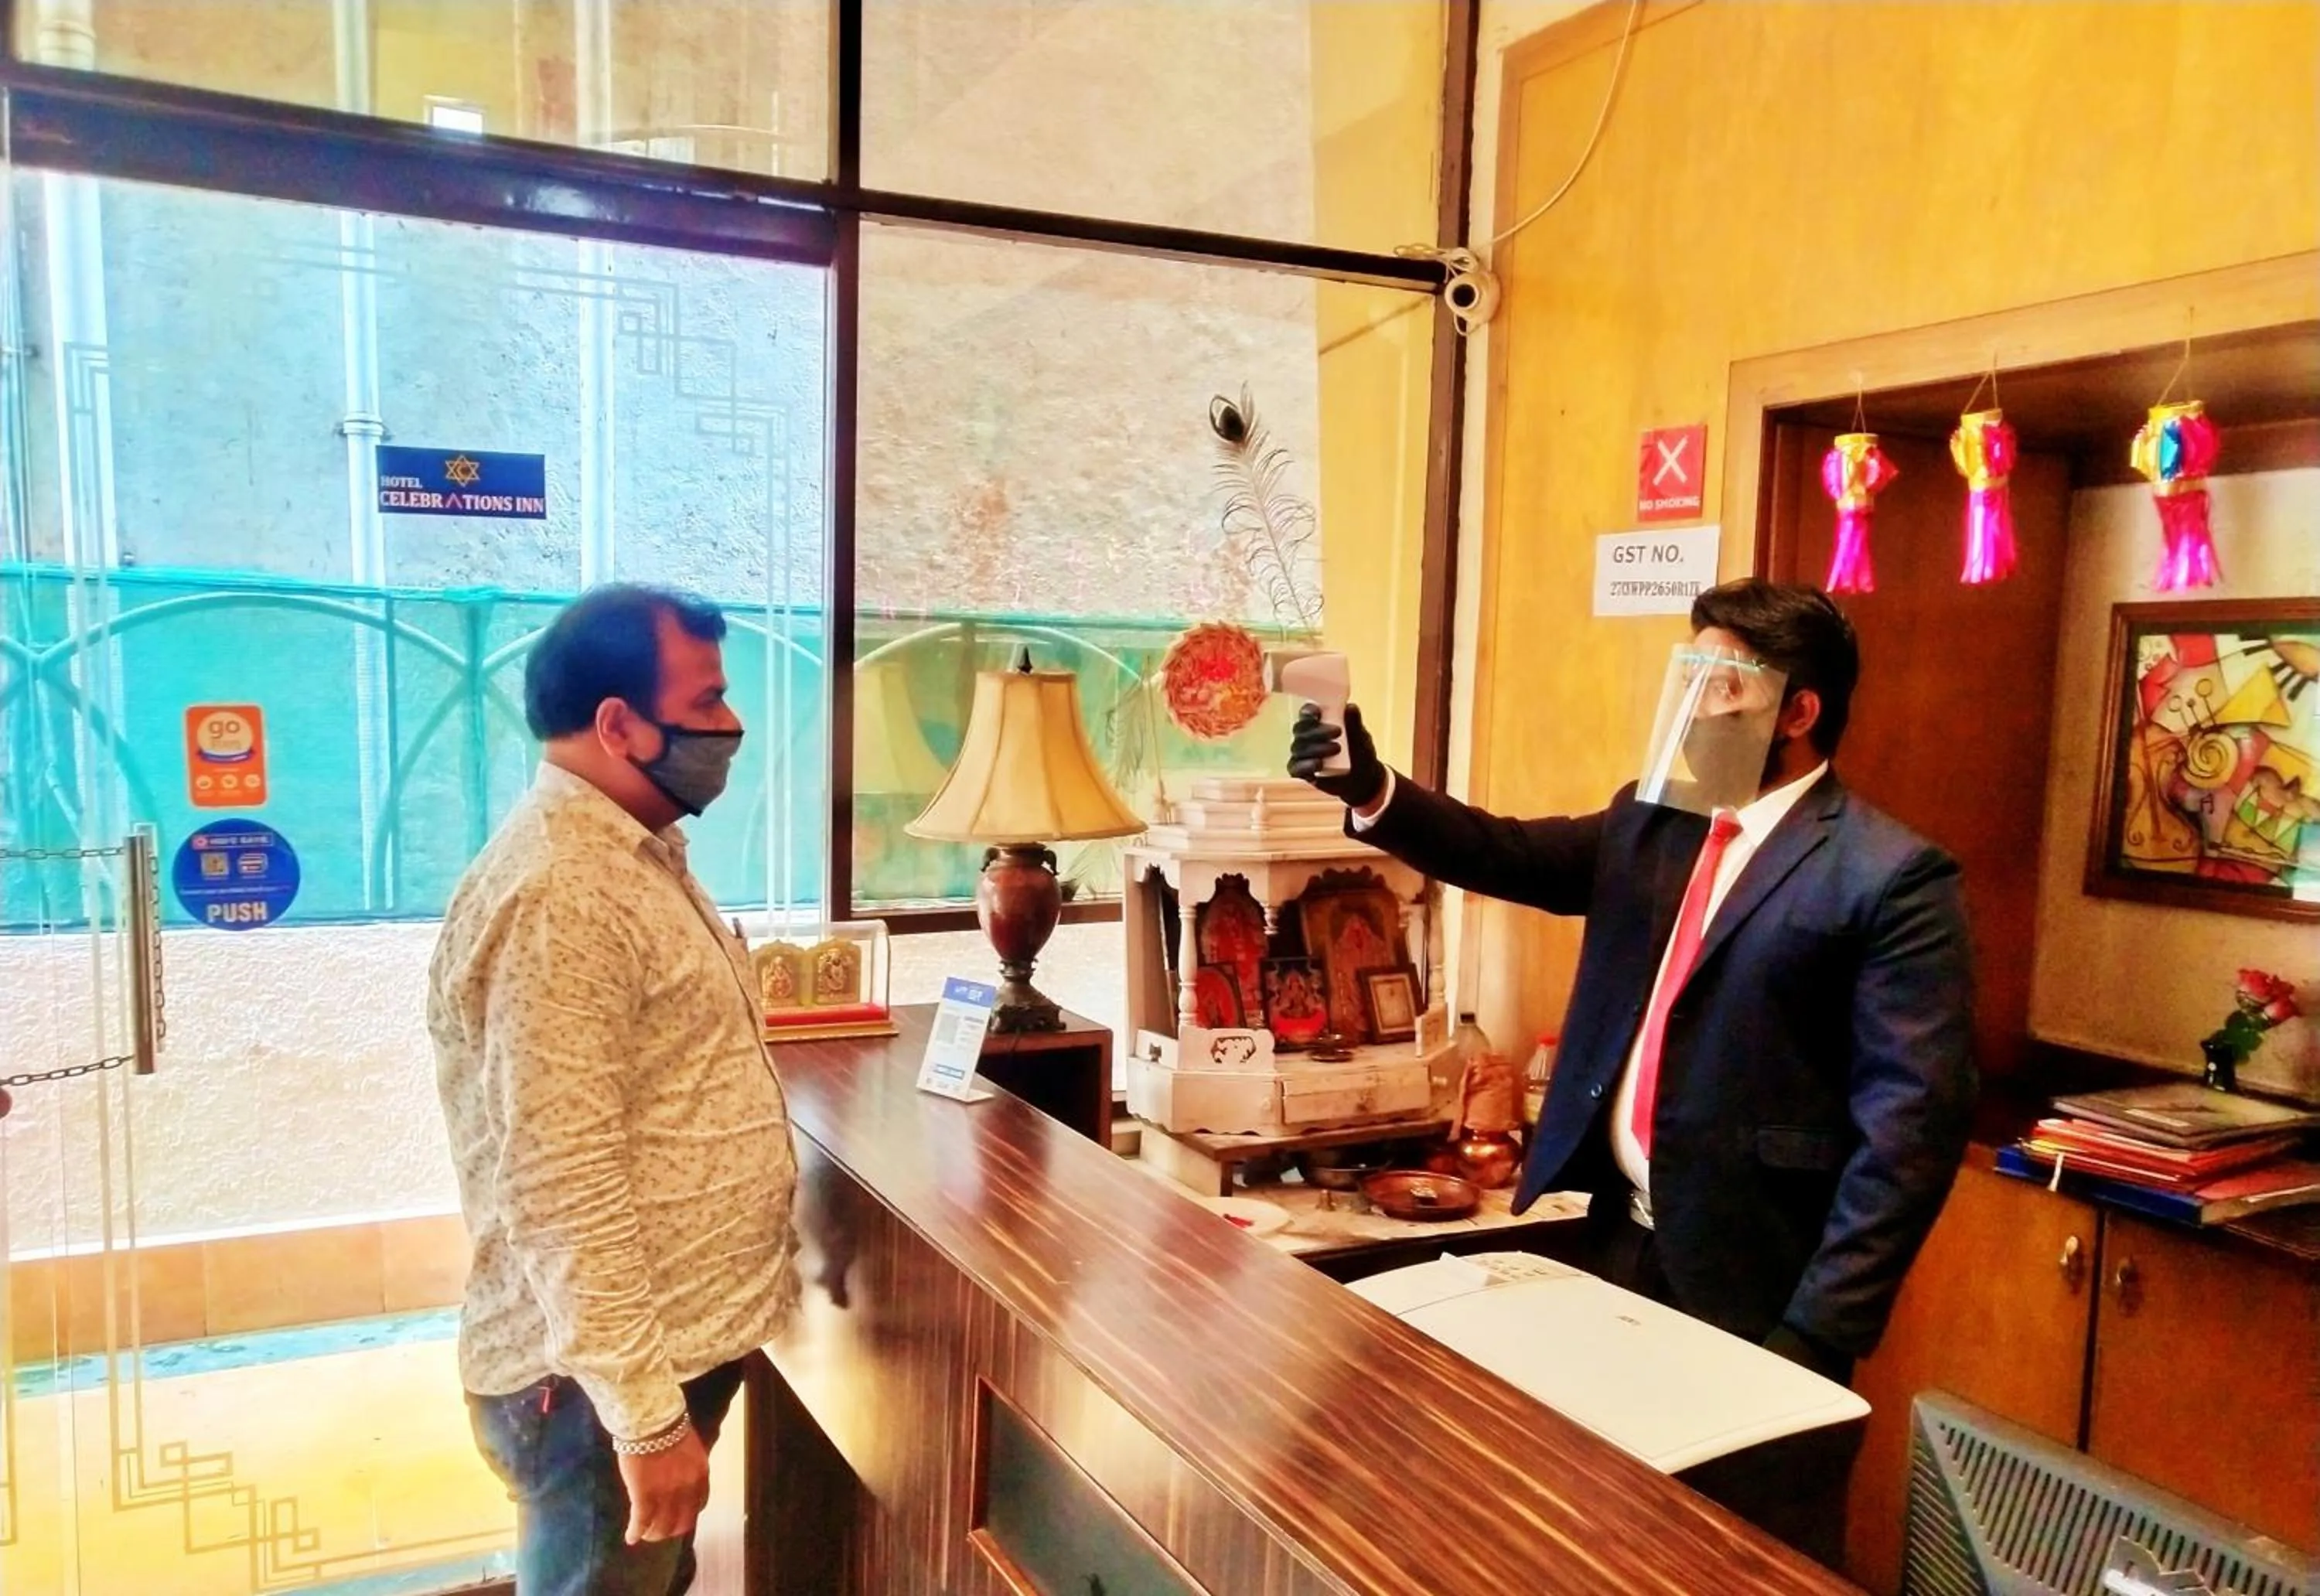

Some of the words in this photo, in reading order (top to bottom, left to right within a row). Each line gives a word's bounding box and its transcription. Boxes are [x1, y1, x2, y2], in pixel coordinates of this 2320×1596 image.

[380, 476, 422, 489] HOTEL
[517, 497, 544, 513] INN
[1639, 500, 1653, 510] NO
[1613, 545, 1646, 563] GST
[209, 720, 241, 739] go
[206, 902, 268, 923] PUSH
